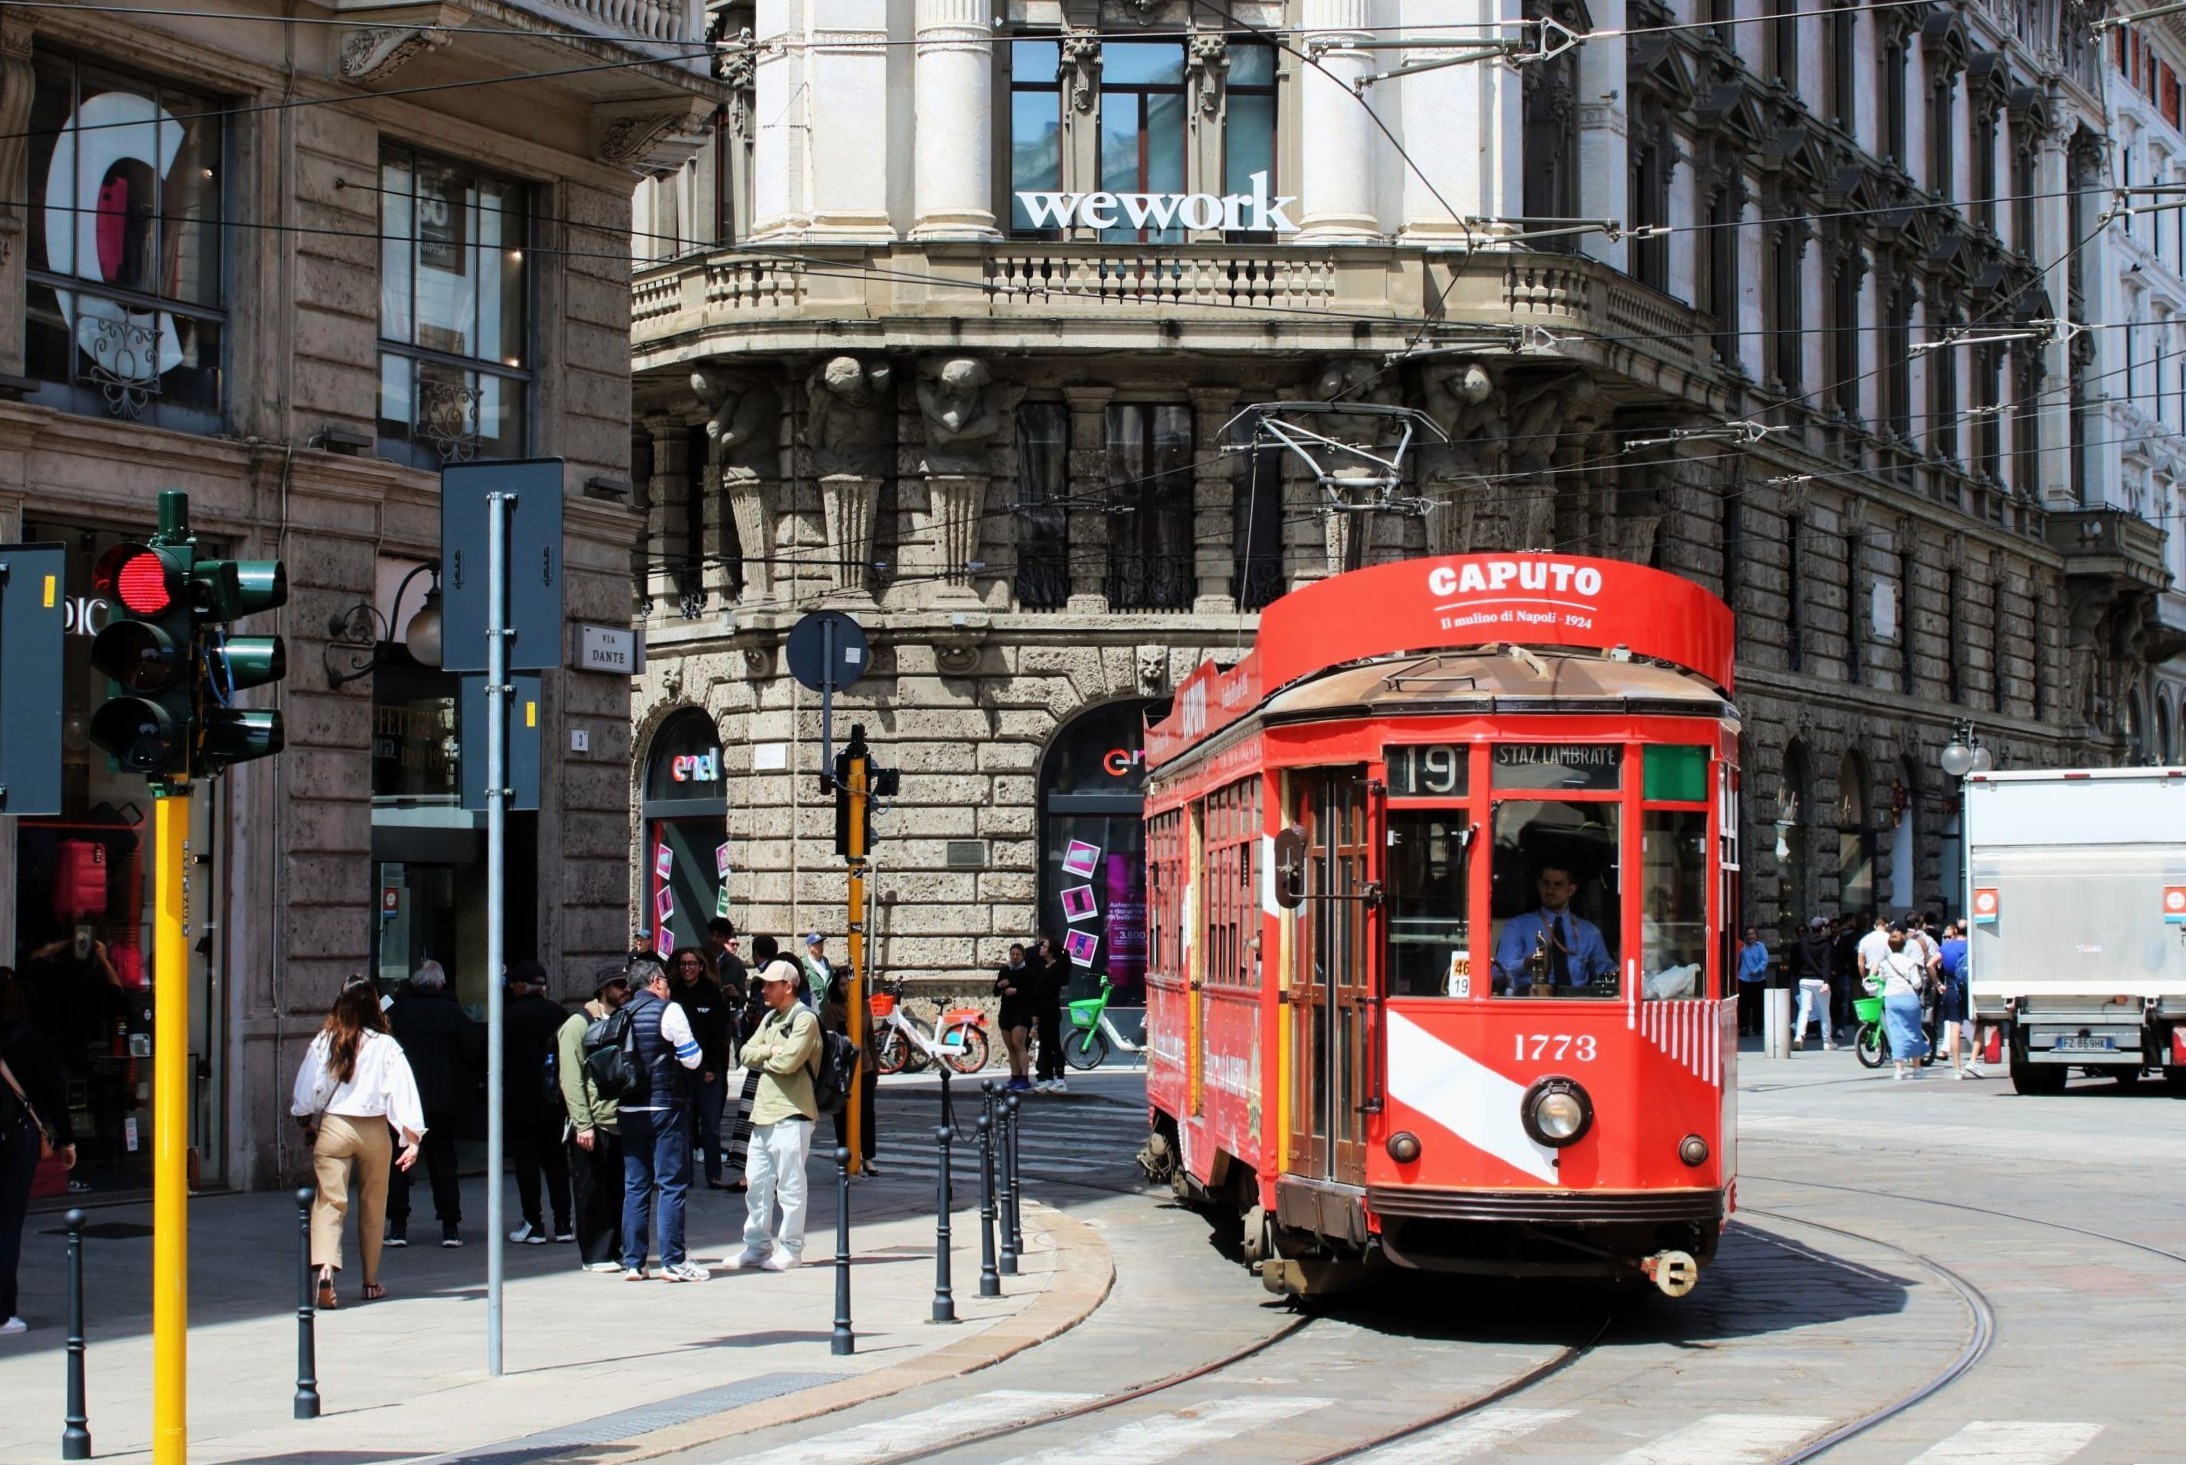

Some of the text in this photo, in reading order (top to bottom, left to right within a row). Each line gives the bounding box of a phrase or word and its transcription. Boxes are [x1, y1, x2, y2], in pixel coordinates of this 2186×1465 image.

[1015, 171, 1301, 231] wework
[1428, 561, 1602, 597] CAPUTO
[1440, 617, 1452, 630] Il
[1454, 611, 1498, 627] mulino
[1500, 610, 1514, 622] di
[1516, 610, 1556, 624] Napoli
[1565, 614, 1592, 629] 1924
[602, 634, 615, 644] VIA
[592, 649, 625, 664] DANTE
[673, 747, 719, 782] enel
[1406, 745, 1456, 794] 19
[1454, 958, 1470, 976] 46
[1454, 979, 1469, 994] 19
[1515, 1034, 1597, 1062] 1773
